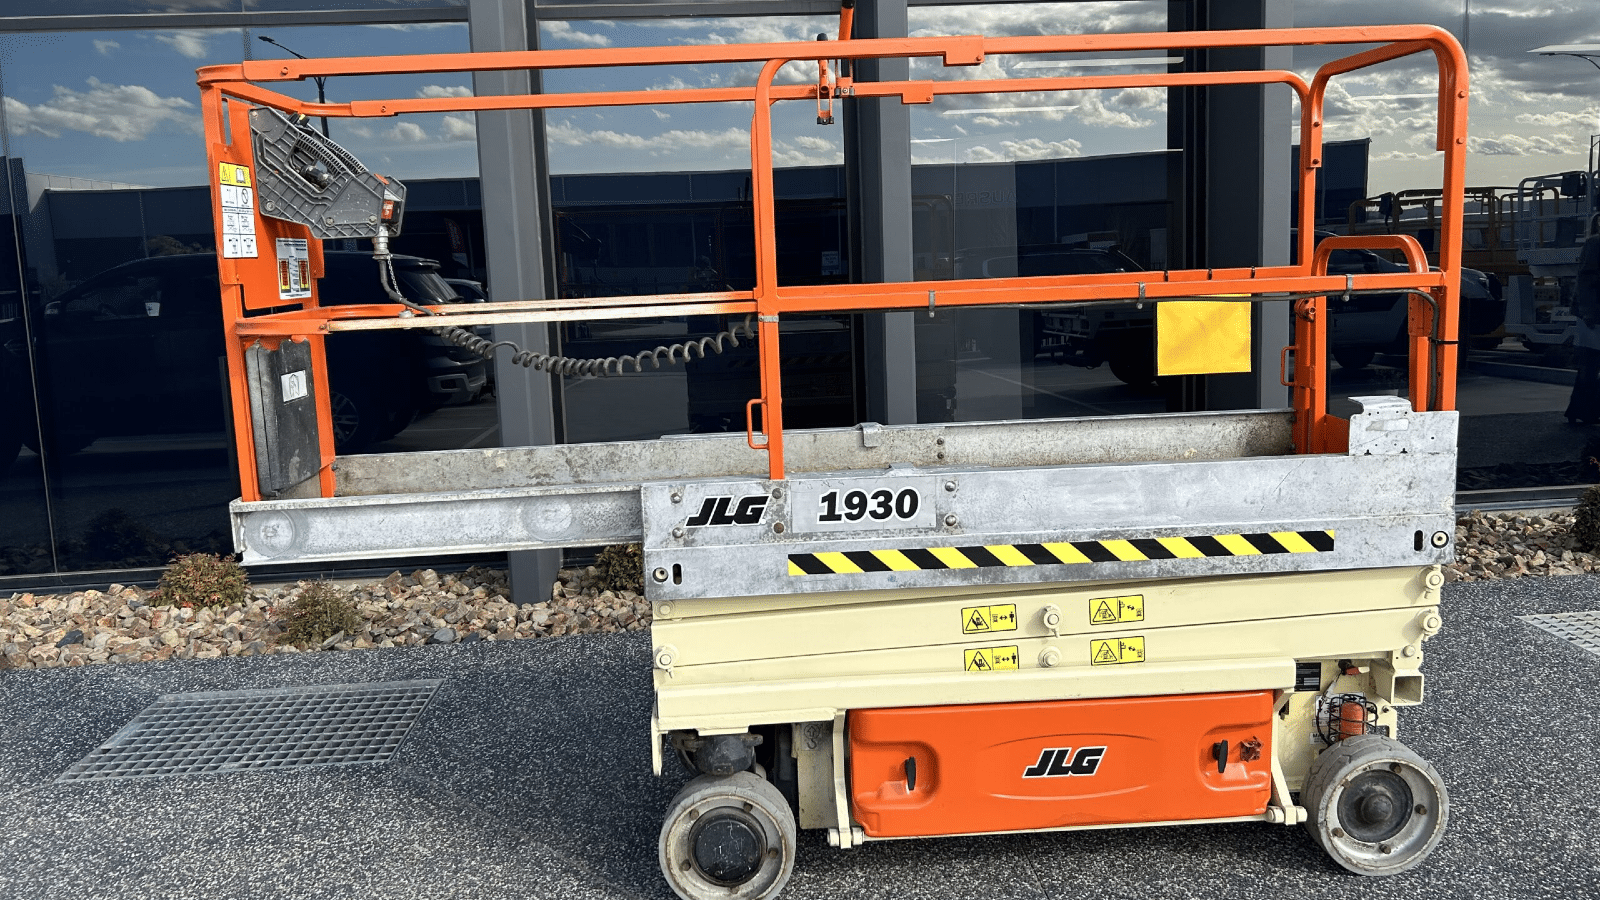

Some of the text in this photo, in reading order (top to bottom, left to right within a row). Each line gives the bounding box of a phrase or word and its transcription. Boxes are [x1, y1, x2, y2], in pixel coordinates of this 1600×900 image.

[685, 487, 920, 527] JLG 1930
[1023, 746, 1106, 778] JLG
